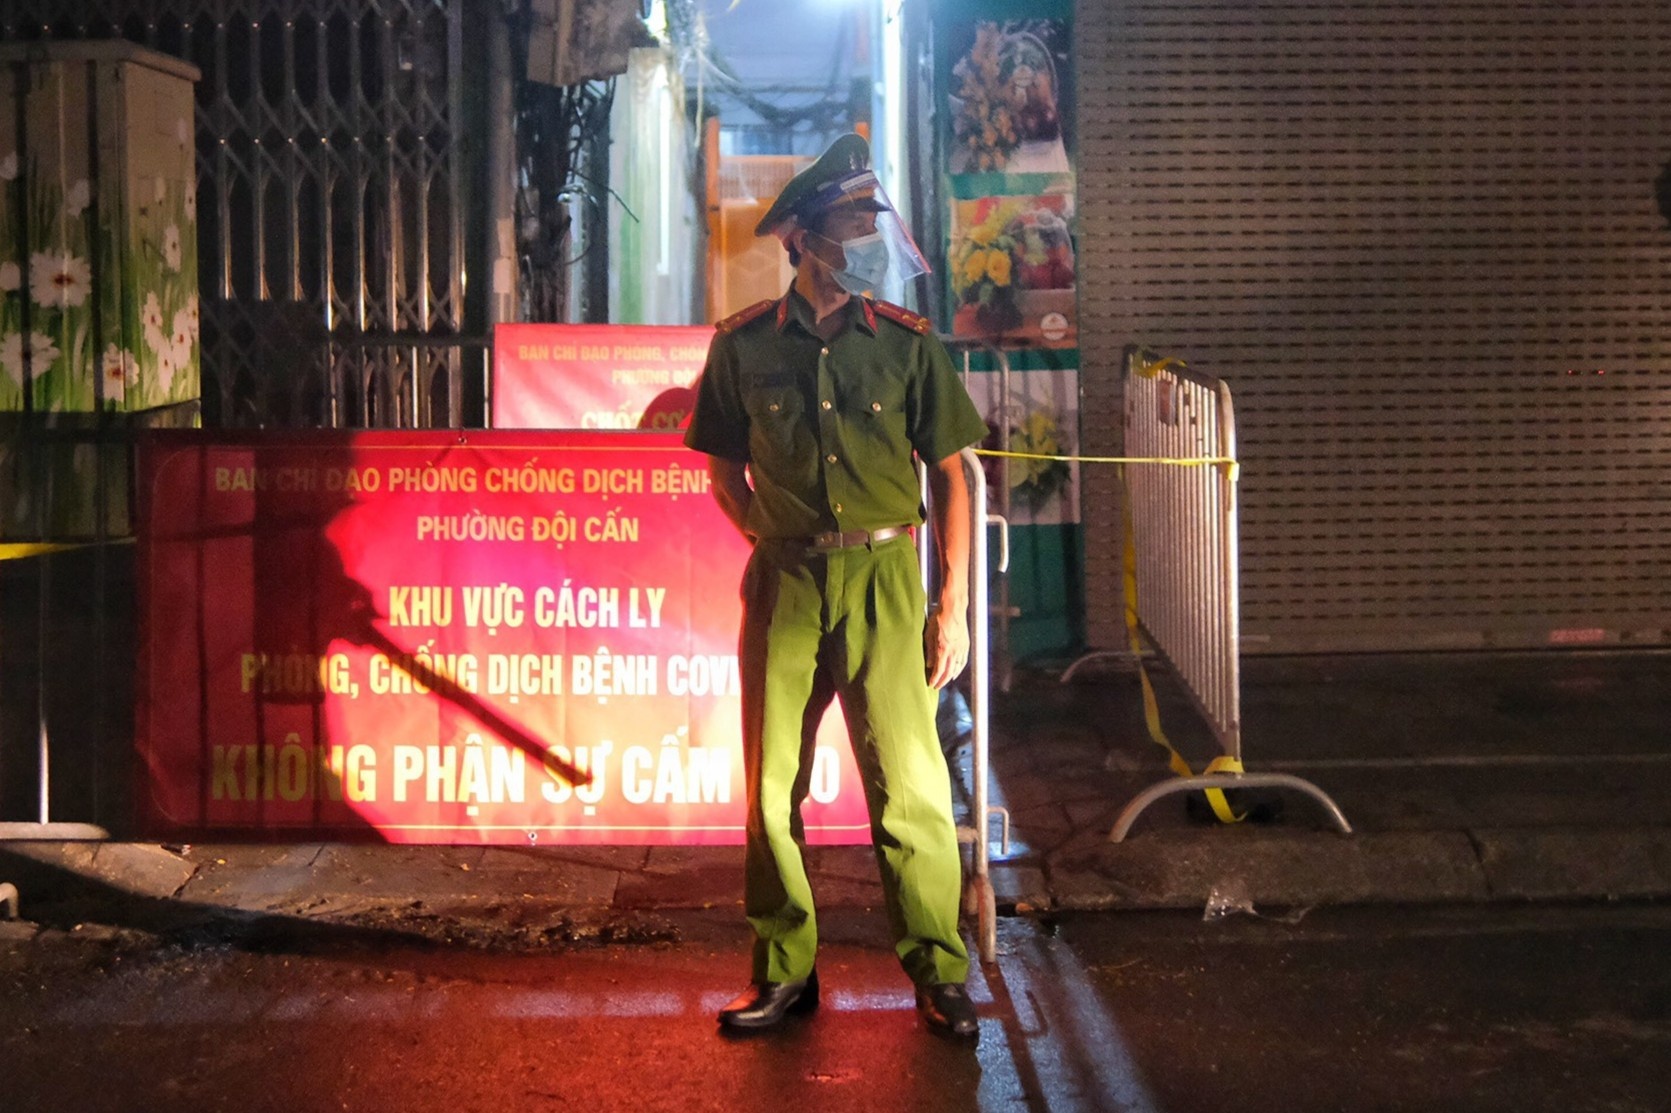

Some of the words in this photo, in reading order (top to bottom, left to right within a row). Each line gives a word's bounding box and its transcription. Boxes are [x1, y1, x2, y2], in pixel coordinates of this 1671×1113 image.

[519, 345, 549, 361] BAN
[215, 467, 268, 492] BAN
[388, 461, 477, 492] PHÒNG
[485, 457, 575, 493] CHỐNG
[583, 468, 643, 500] DỊCH
[651, 462, 711, 501] BỆNH
[417, 509, 525, 541] PHƯỜNG
[532, 510, 576, 549] ĐỘI
[584, 506, 639, 542] CẤN
[389, 586, 452, 627] KHU
[462, 582, 525, 635] VỰC
[534, 578, 619, 628] CÁCH
[629, 587, 666, 628] LY
[369, 639, 478, 695] CHỐNG
[487, 653, 562, 703] DỊCH
[572, 646, 657, 704] BỆNH
[667, 654, 741, 697] COVI
[210, 732, 377, 802] KHÔNG
[393, 733, 526, 816] PHẬN
[541, 740, 613, 816] SỰ
[621, 726, 732, 804] CẤM
